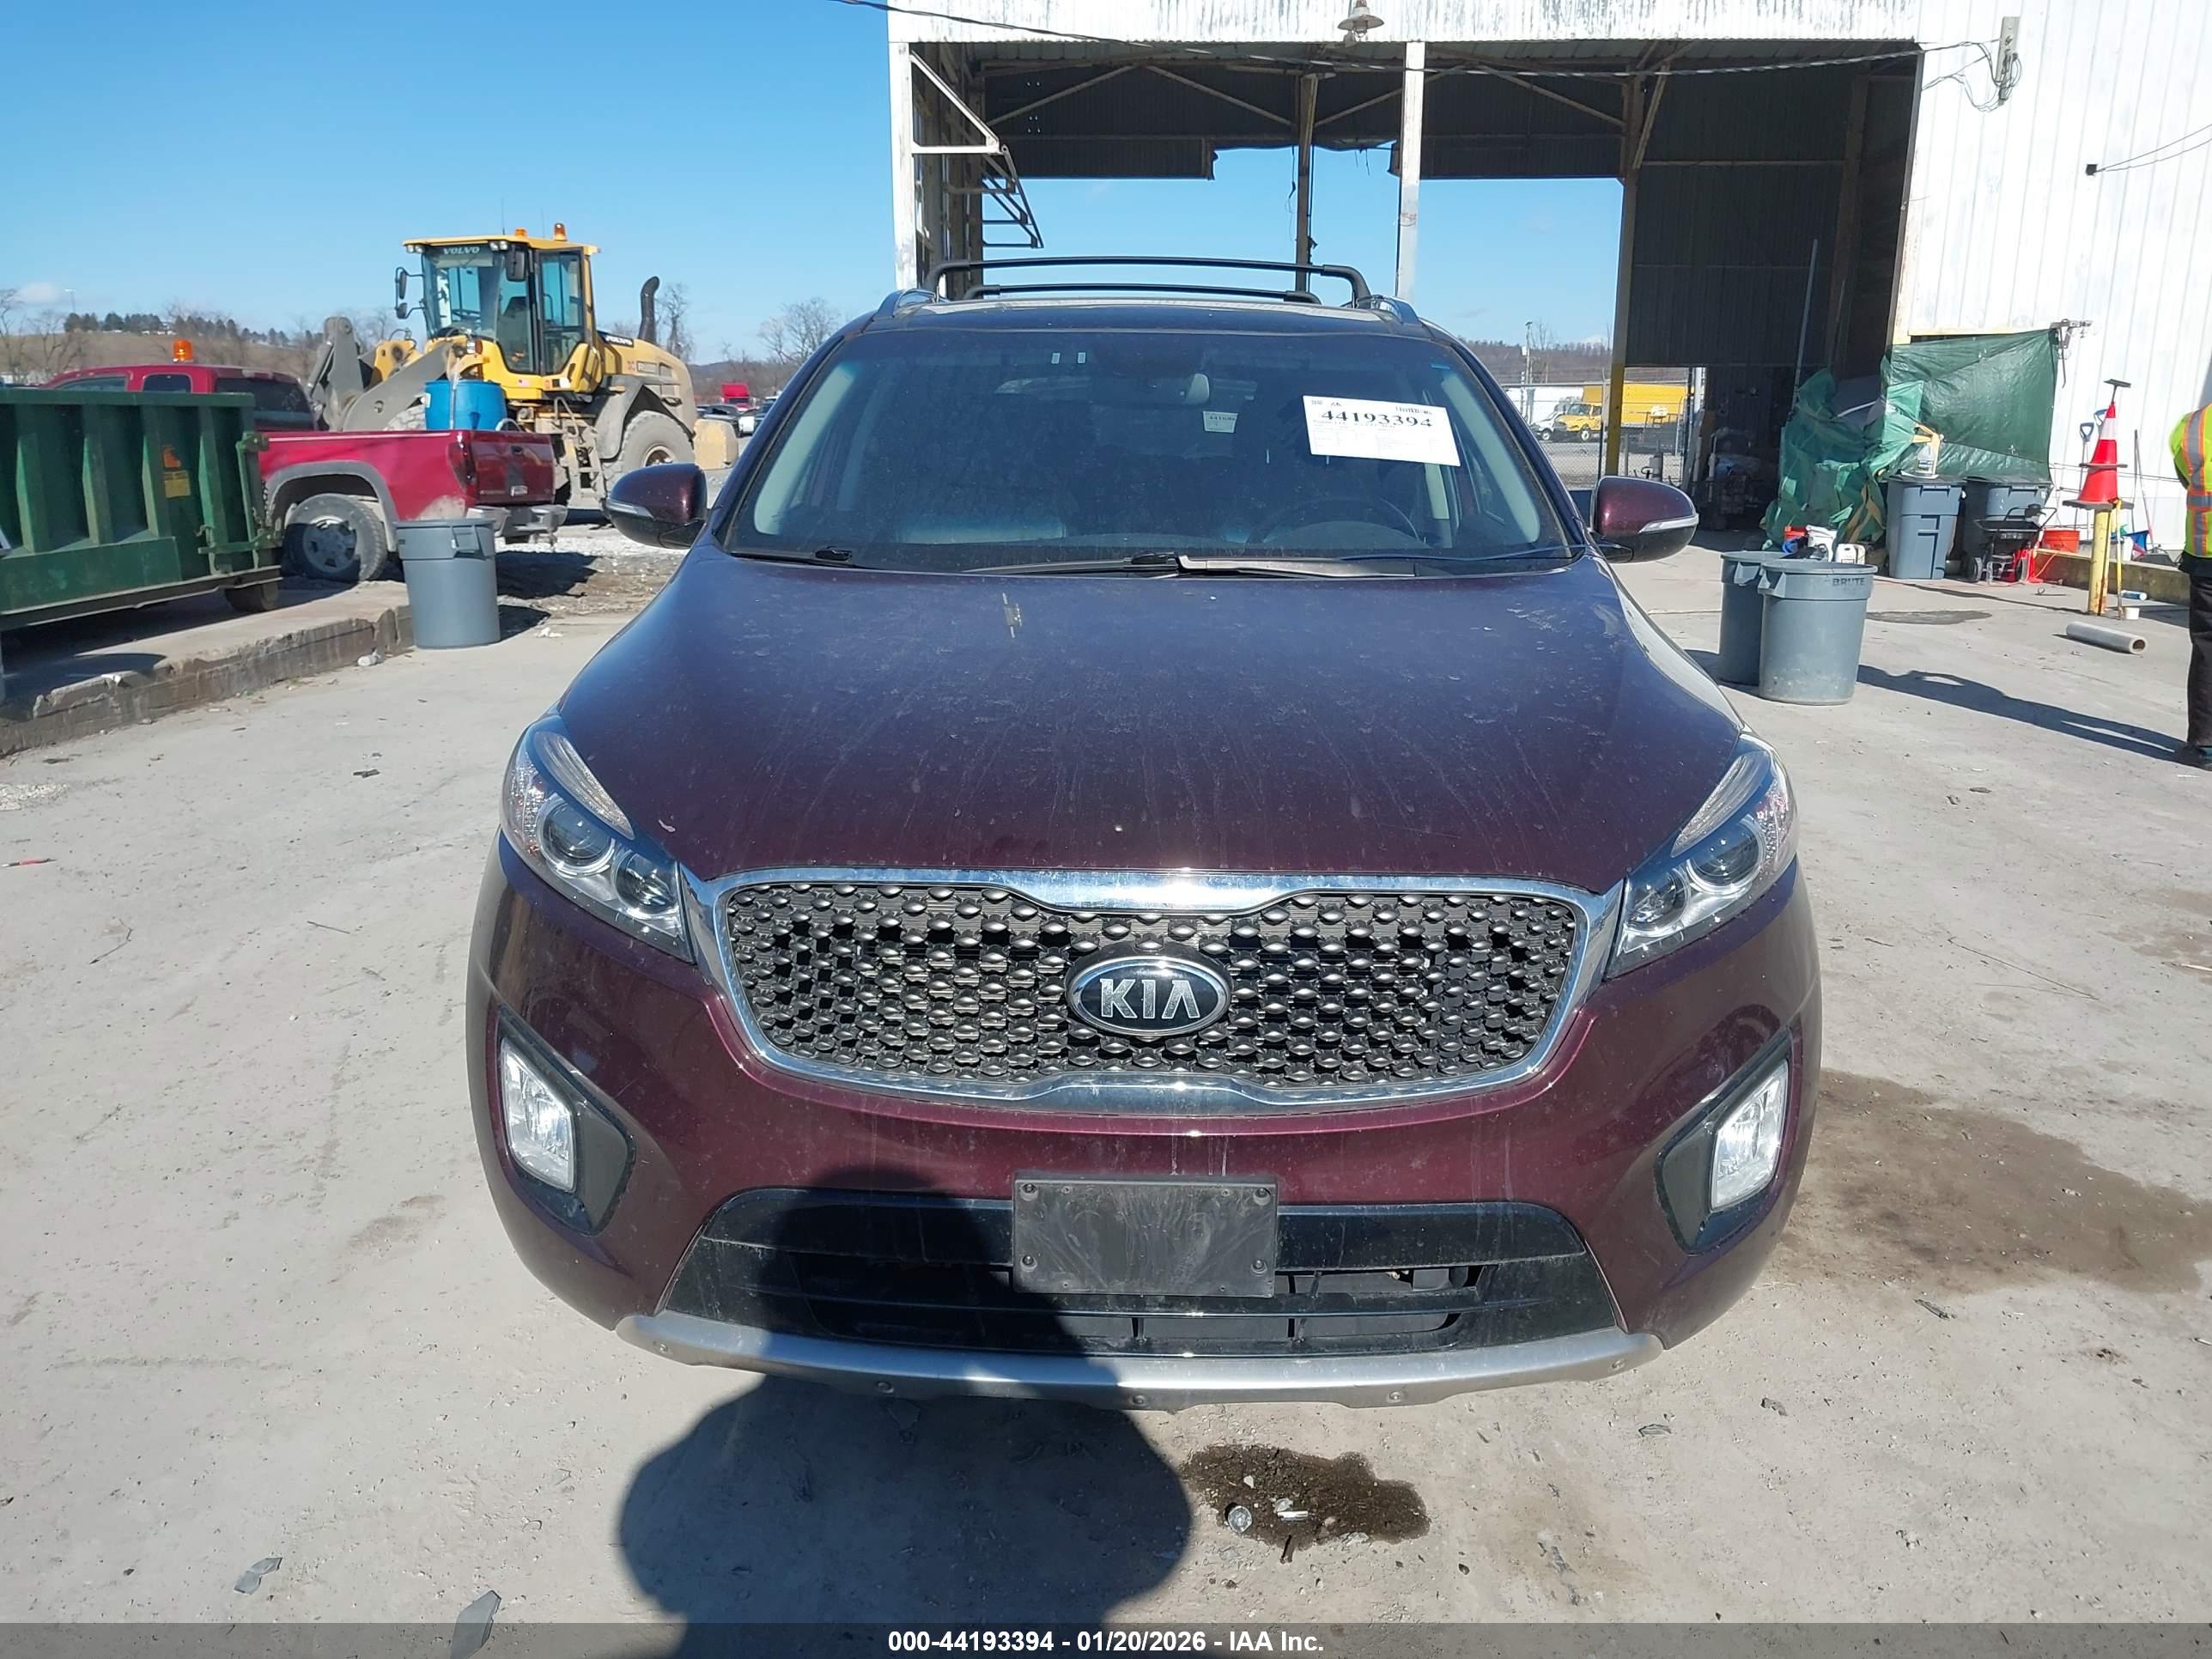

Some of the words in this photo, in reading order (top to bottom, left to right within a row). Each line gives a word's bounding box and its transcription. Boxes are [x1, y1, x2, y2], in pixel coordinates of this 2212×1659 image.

[443, 246, 480, 255] VOLVO
[1321, 409, 1433, 428] 44193394
[1832, 577, 1866, 586] BRUTE
[1099, 978, 1200, 1019] KIA
